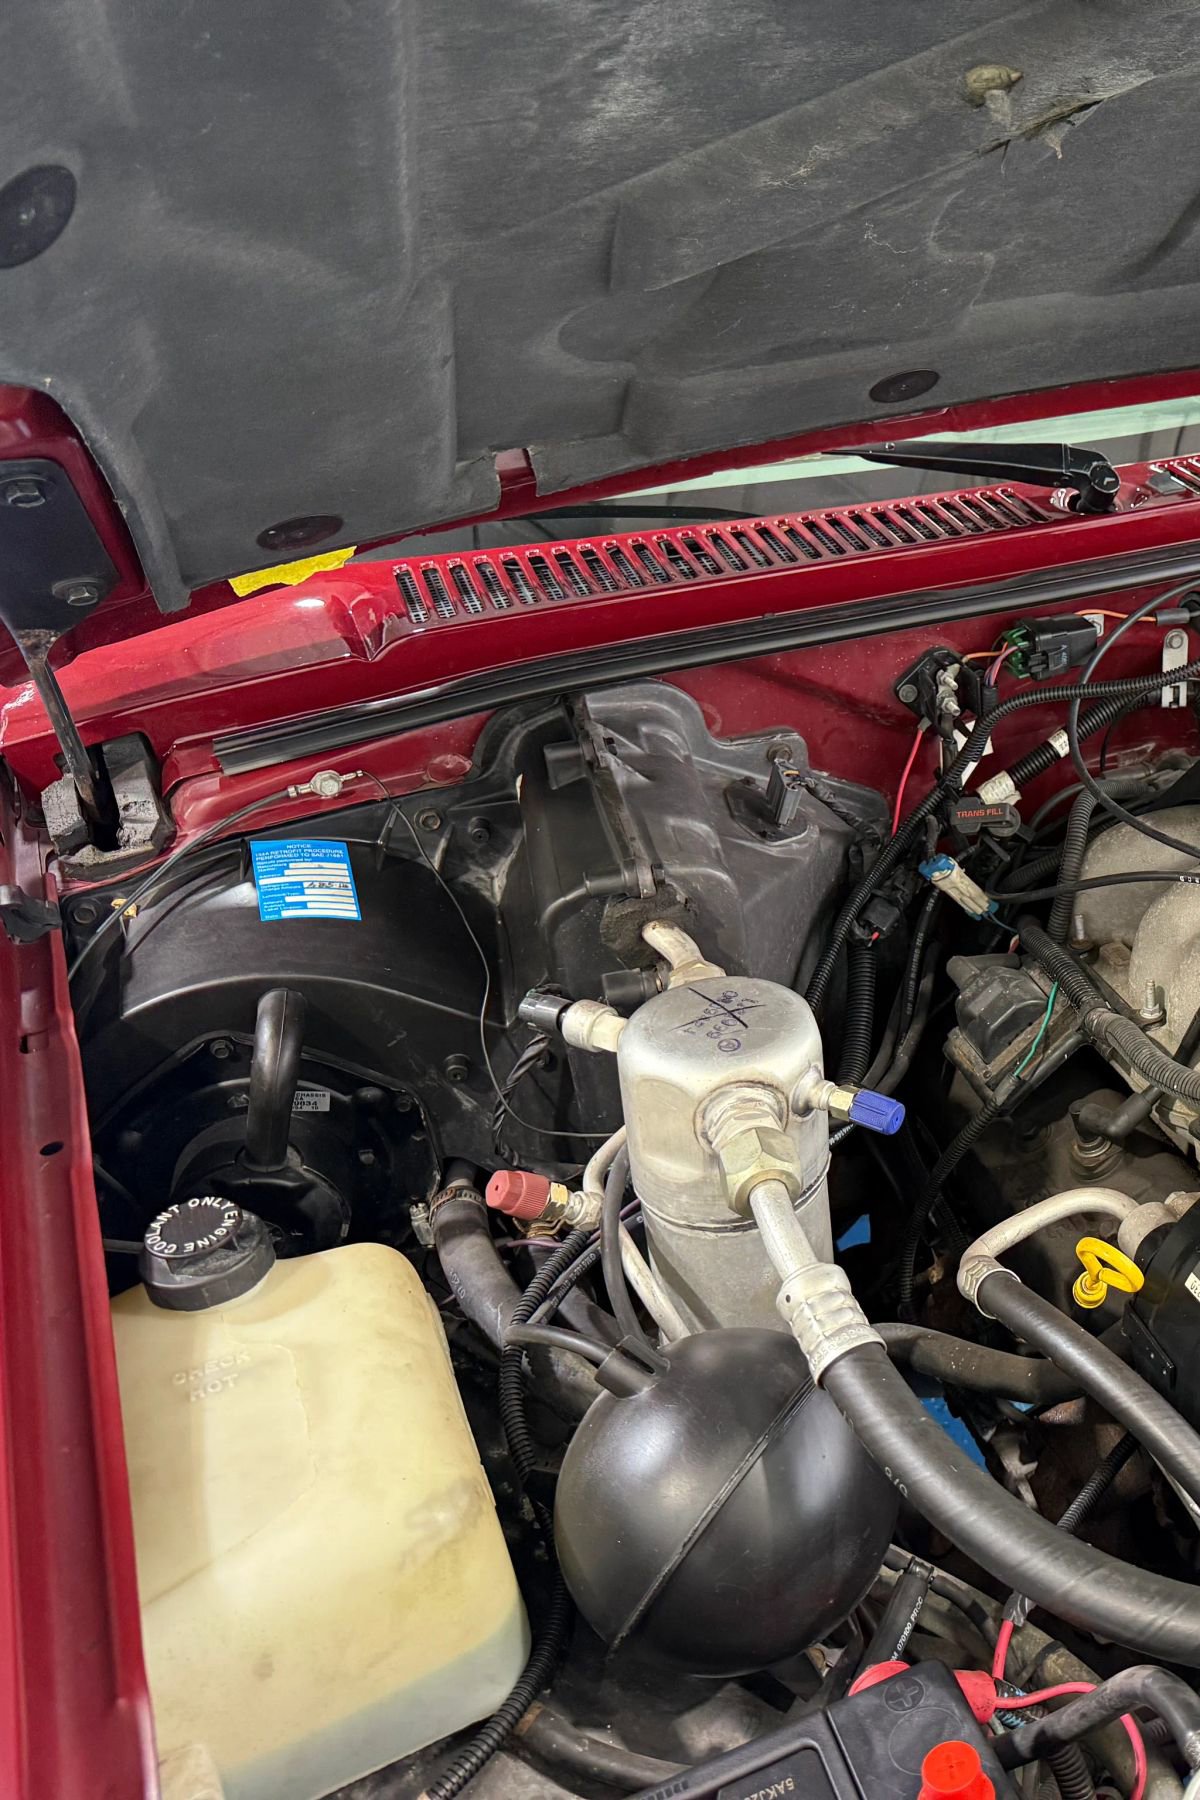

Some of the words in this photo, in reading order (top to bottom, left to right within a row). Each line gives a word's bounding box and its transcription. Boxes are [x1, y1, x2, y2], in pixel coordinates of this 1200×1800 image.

[956, 809, 985, 818] TRANS
[986, 807, 1004, 816] FILL
[187, 1196, 235, 1210] ONLY
[145, 1204, 180, 1254] COOLANT
[183, 1210, 239, 1253] ENGINE
[172, 1351, 251, 1385] CHECK
[190, 1373, 239, 1402] HOT
[745, 1776, 796, 1800] 5AKJ2
